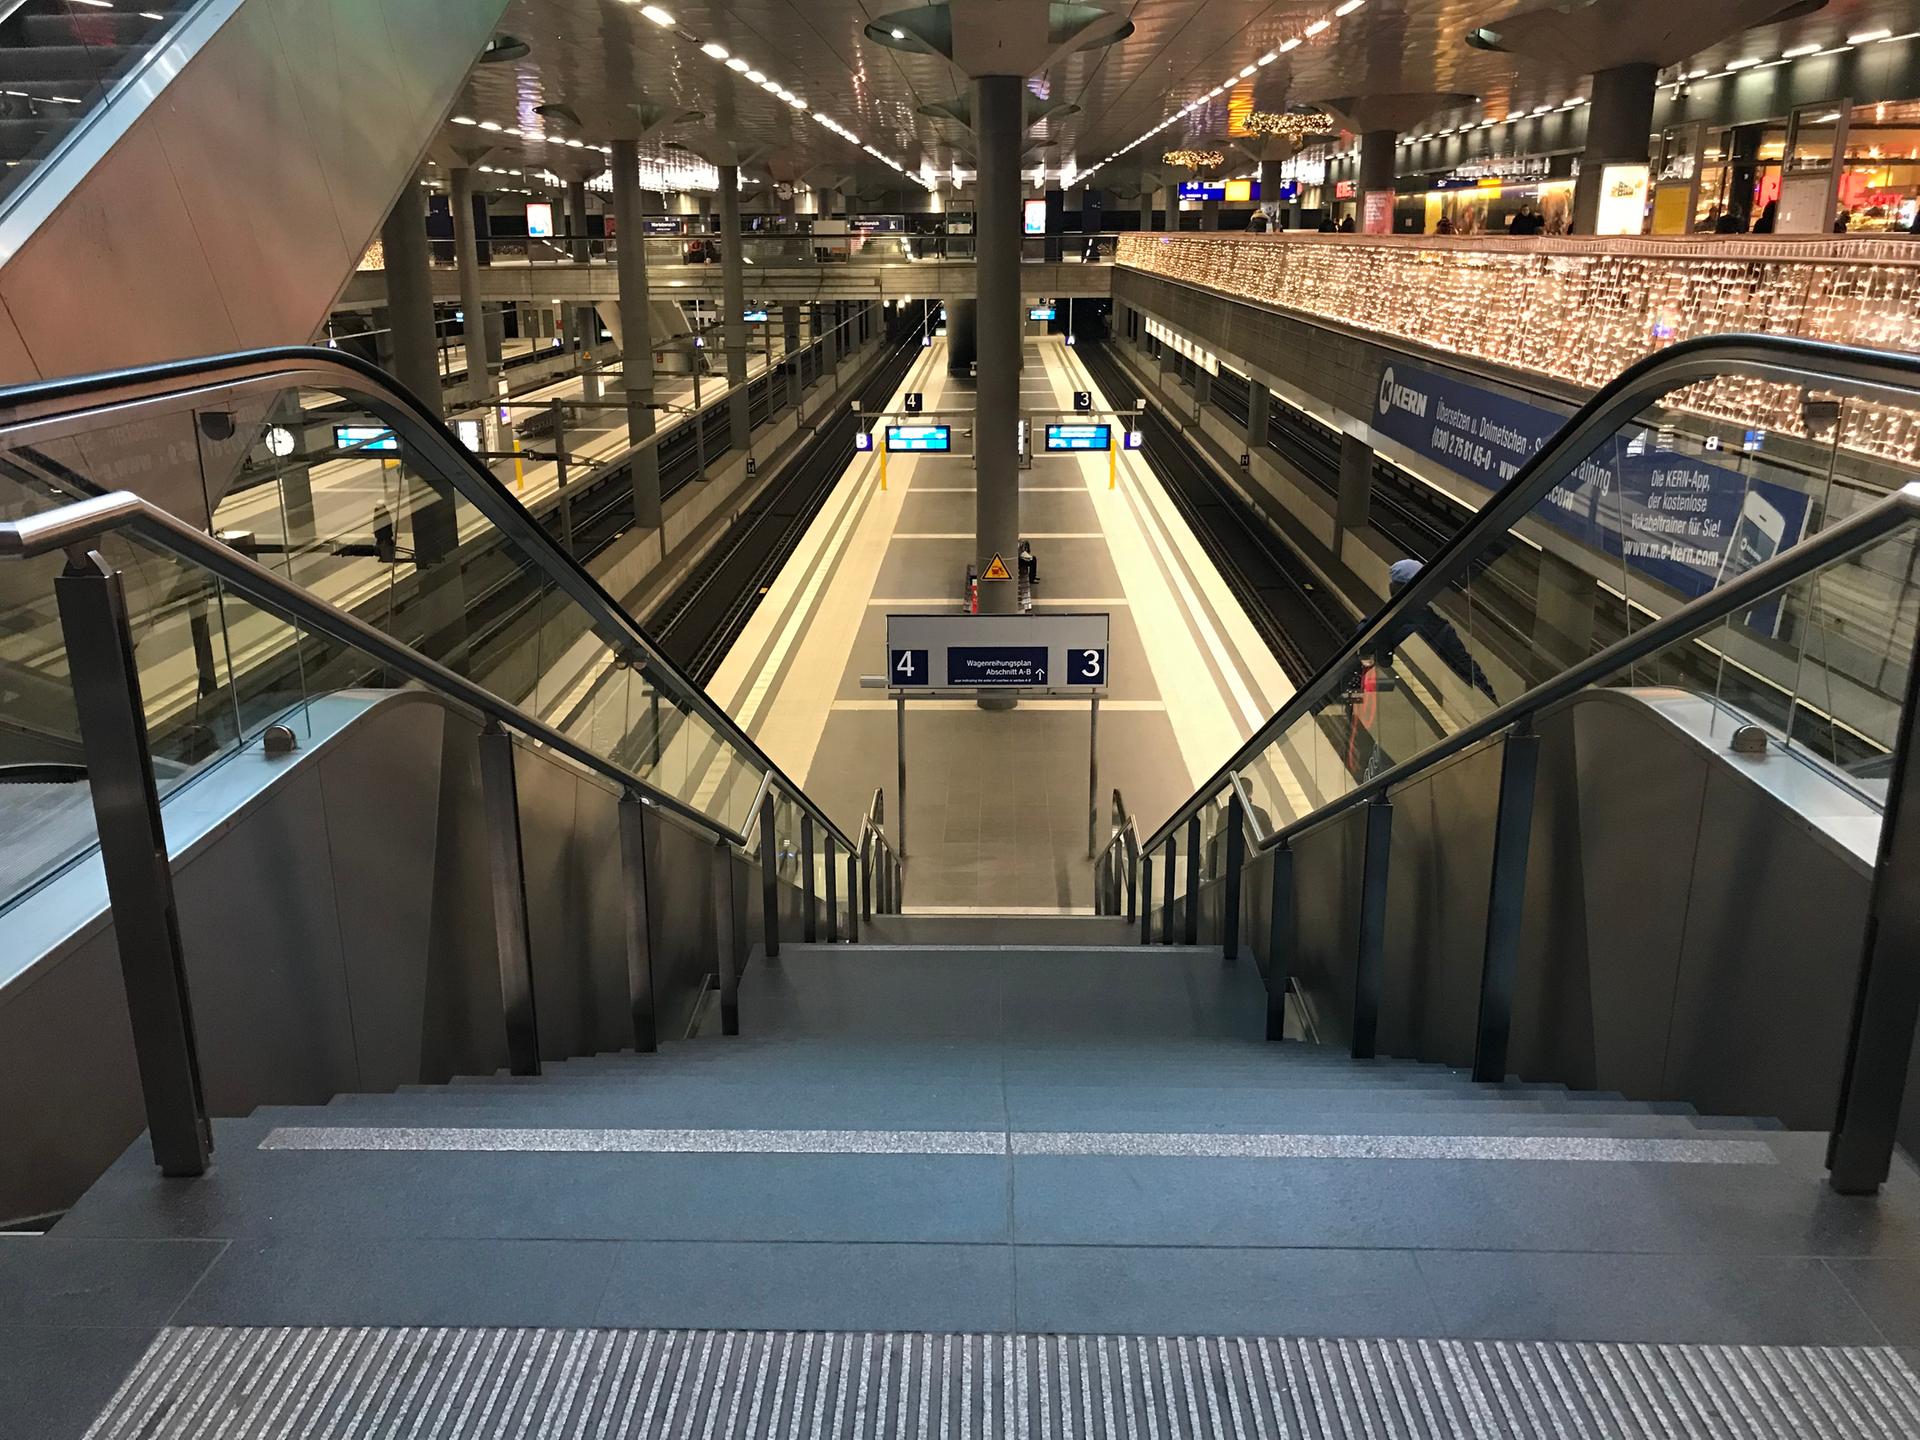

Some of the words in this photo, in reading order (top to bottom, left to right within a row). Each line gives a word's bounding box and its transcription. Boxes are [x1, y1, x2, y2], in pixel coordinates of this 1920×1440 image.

[907, 394, 916, 408] 4
[1080, 392, 1090, 406] 3
[1392, 384, 1428, 418] KERN
[1436, 396, 1471, 431] Übersetzen
[1479, 416, 1527, 455] Dolmetschen
[856, 433, 868, 449] B
[1129, 431, 1142, 447] B
[1651, 470, 1664, 487] Die
[1666, 470, 1711, 493] KERN-App,
[1648, 492, 1662, 509] der
[1662, 492, 1708, 512] kostenlose
[1631, 513, 1687, 534] Vokabeltrainer
[1688, 516, 1702, 536] für
[1702, 518, 1721, 538] Sie!
[1624, 540, 1719, 568] www.m.e-kern.com
[896, 651, 915, 677] 4
[966, 660, 1032, 668] Wagenreihungsplan
[1081, 649, 1100, 677] 3
